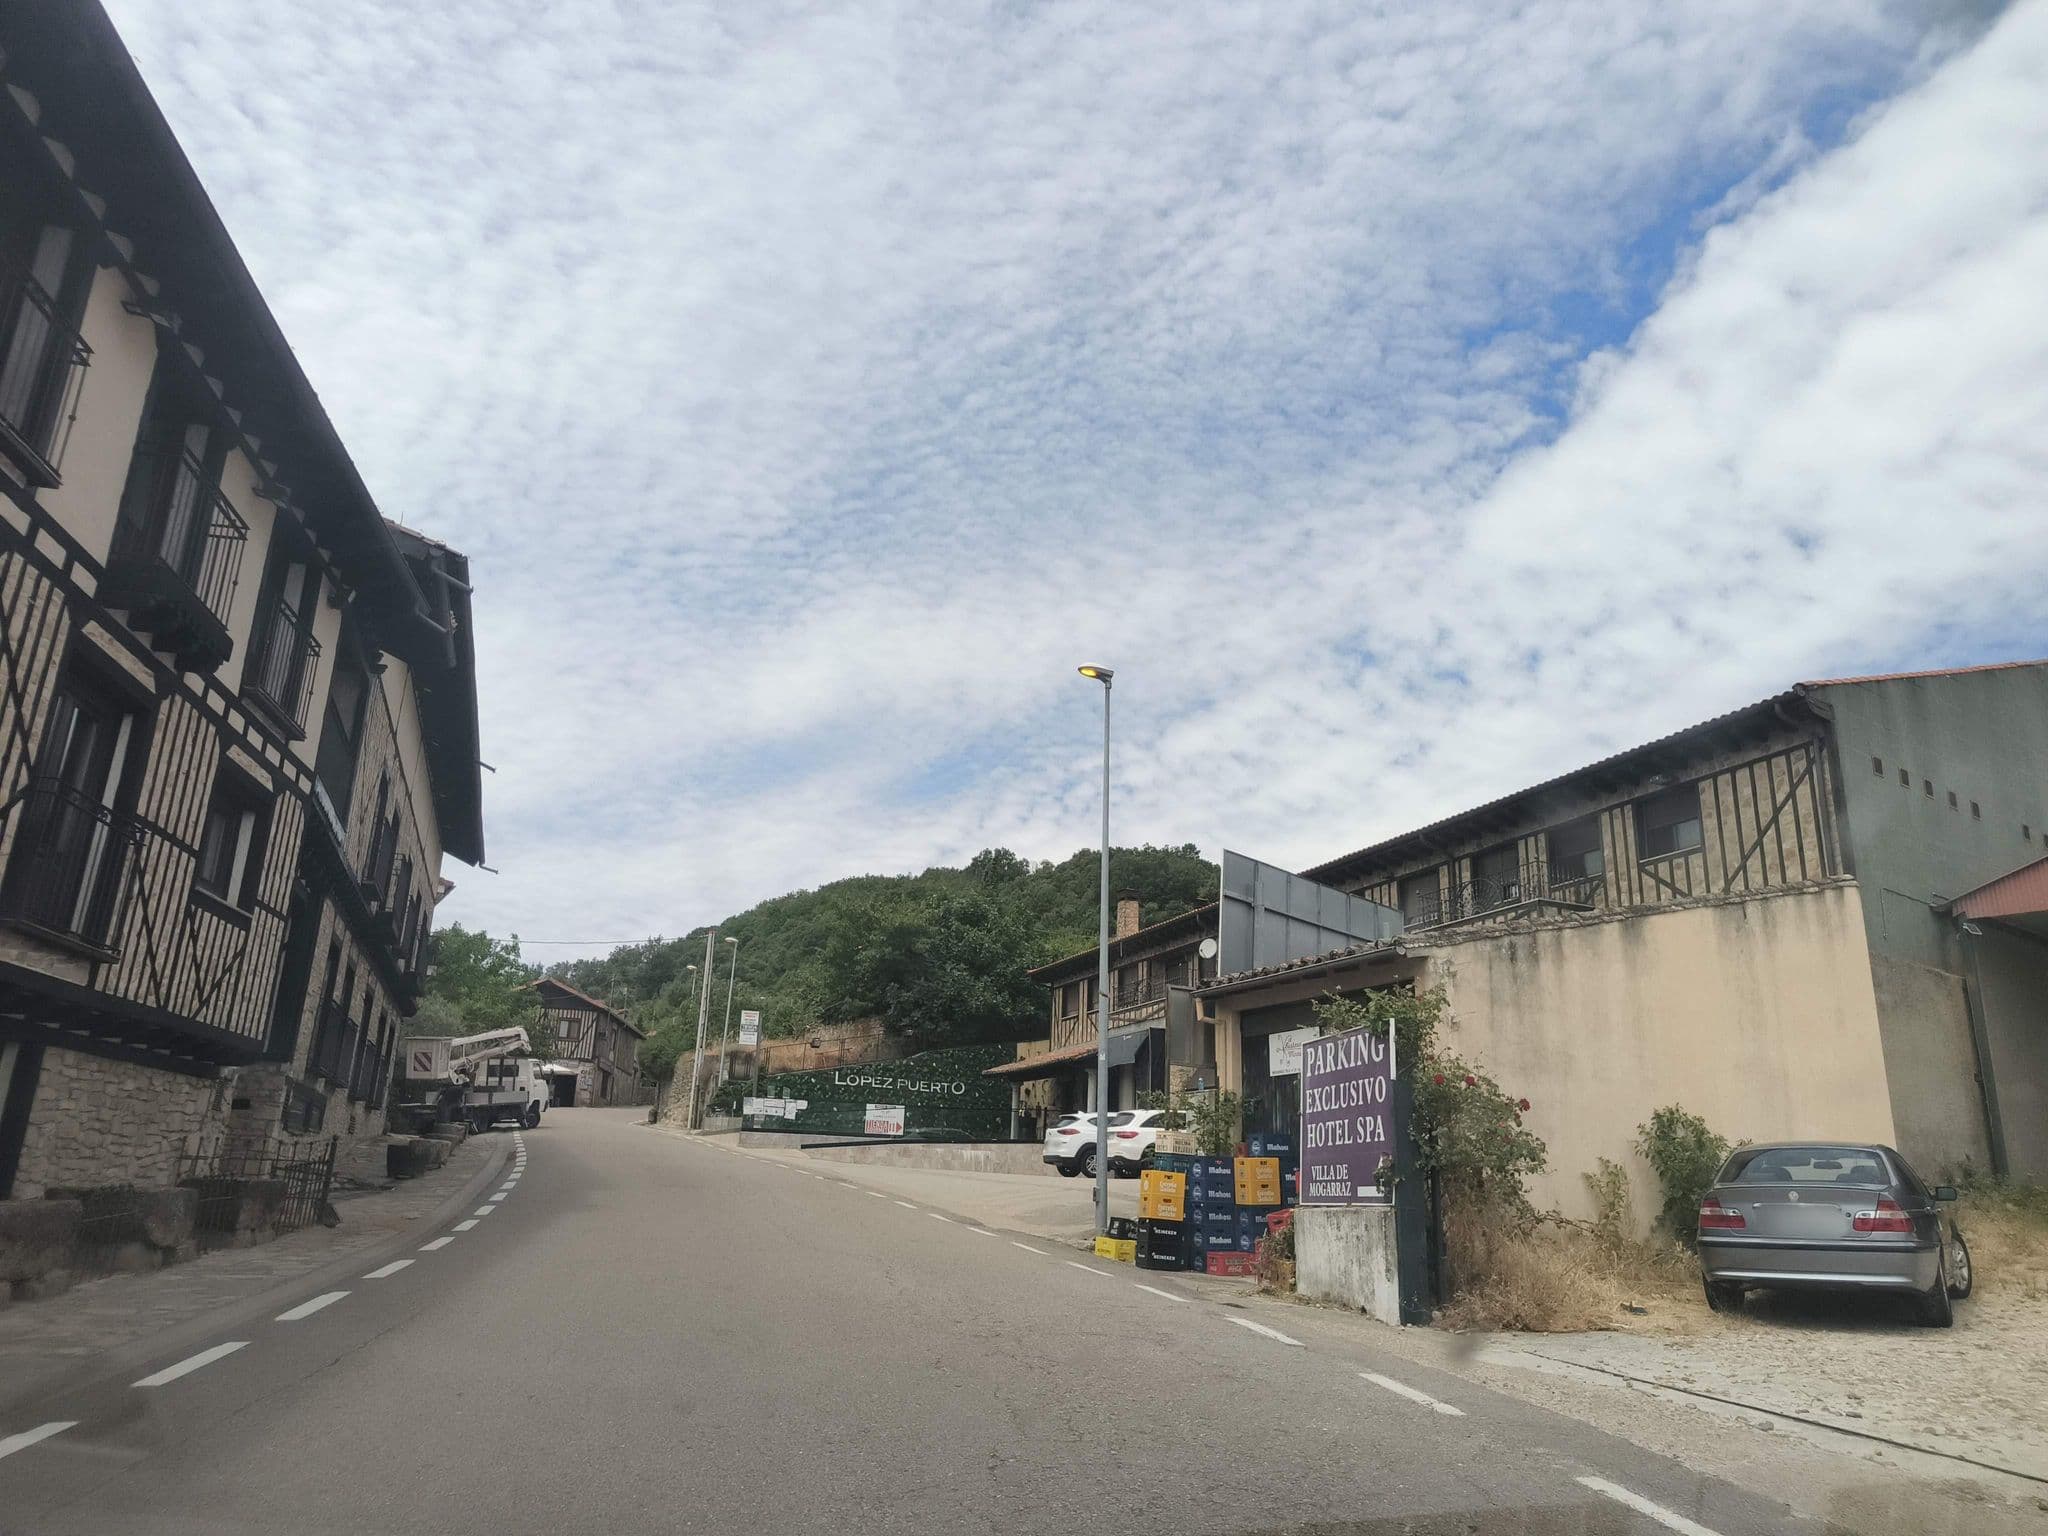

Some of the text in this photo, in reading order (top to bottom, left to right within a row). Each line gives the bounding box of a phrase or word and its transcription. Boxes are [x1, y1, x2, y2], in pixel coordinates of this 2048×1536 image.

[1306, 1032, 1385, 1078] PARKING
[834, 1071, 965, 1095] LOPEZ PUERTO
[1305, 1075, 1386, 1114] EXCLUSIVO
[1307, 1114, 1386, 1148] HOTEL SPA
[1266, 1143, 1289, 1151] Mahou
[1208, 1166, 1231, 1175] Mahou
[1311, 1164, 1335, 1181] VILLA
[1336, 1164, 1349, 1180] DE
[1208, 1190, 1232, 1198] Mahou
[1309, 1181, 1352, 1197] MOGARRAZ
[1208, 1212, 1232, 1220] Mahou
[1209, 1236, 1232, 1244] Mahou
